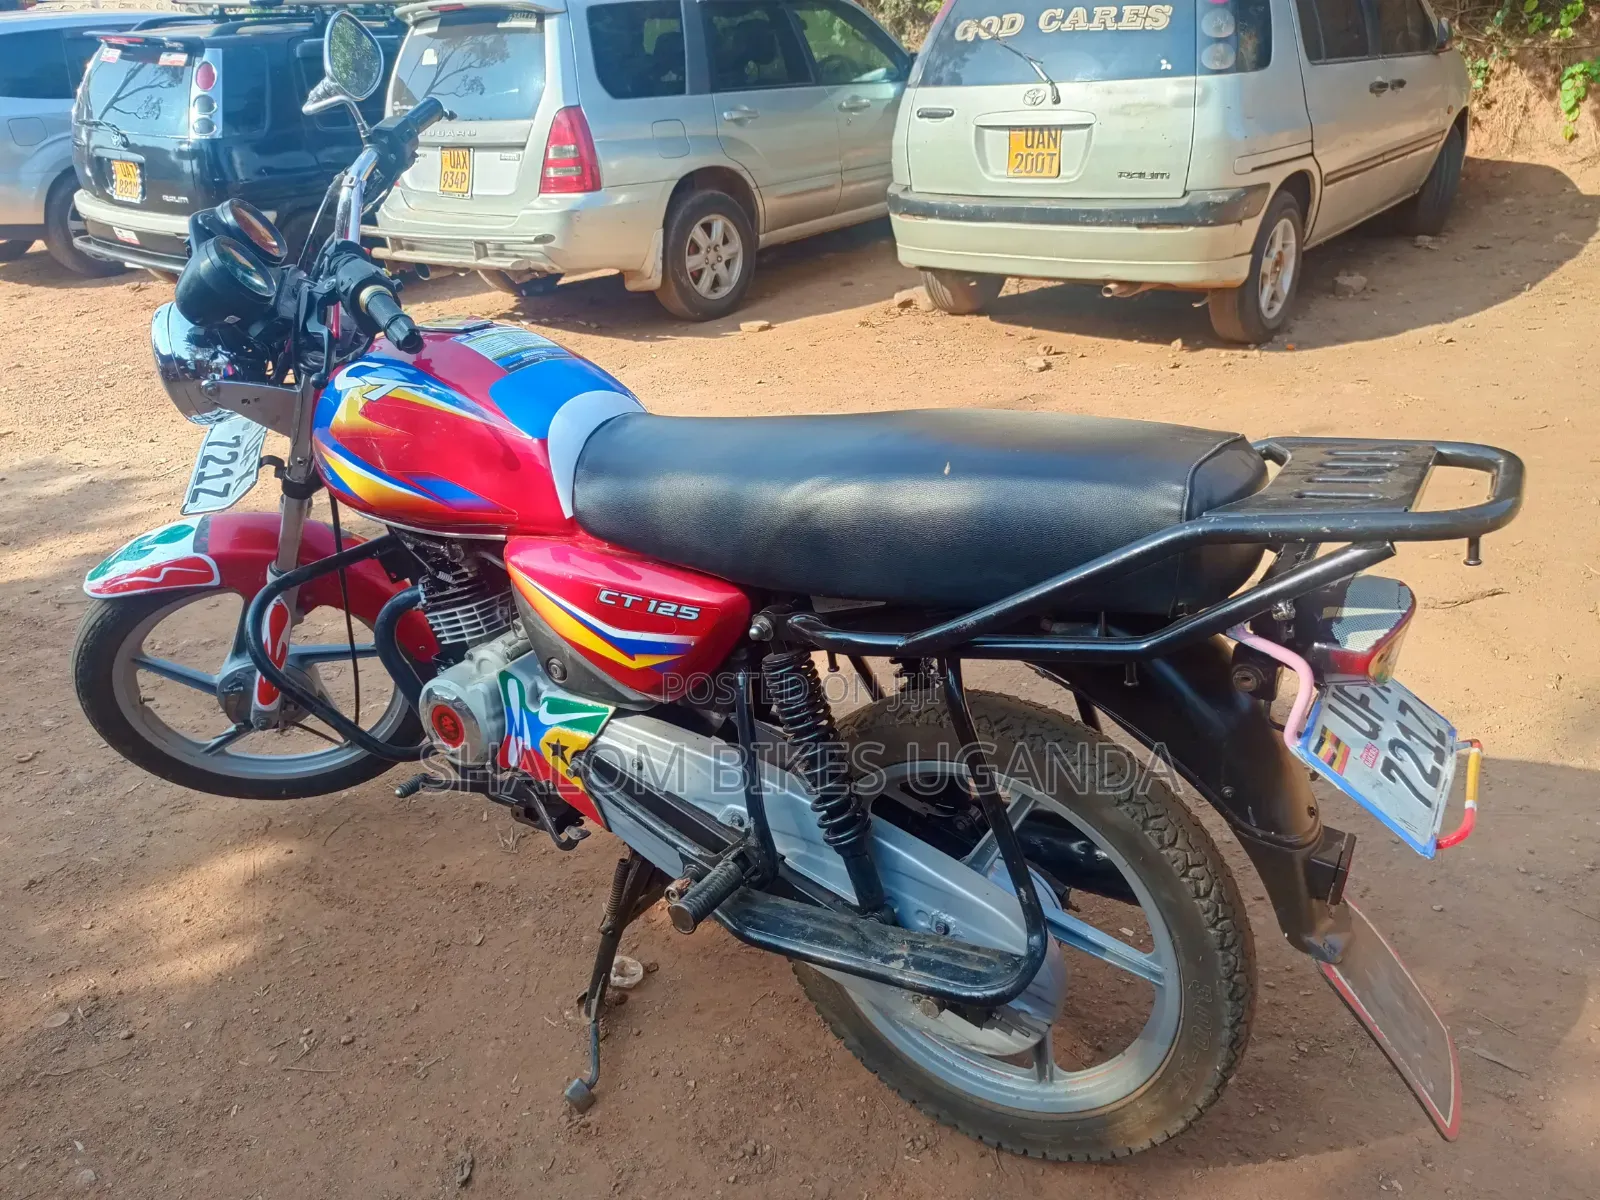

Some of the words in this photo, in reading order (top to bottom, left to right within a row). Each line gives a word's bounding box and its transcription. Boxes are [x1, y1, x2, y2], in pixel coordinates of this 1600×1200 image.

[954, 13, 1025, 41] GOD
[1038, 5, 1173, 33] CARES
[1024, 127, 1058, 149] UAN
[449, 150, 468, 170] UAX
[1012, 152, 1057, 174] 200T
[442, 171, 467, 190] 934P
[189, 435, 241, 504] 721Z
[598, 588, 643, 609] CT
[646, 599, 701, 621] 125
[1380, 700, 1446, 808] 721Z
